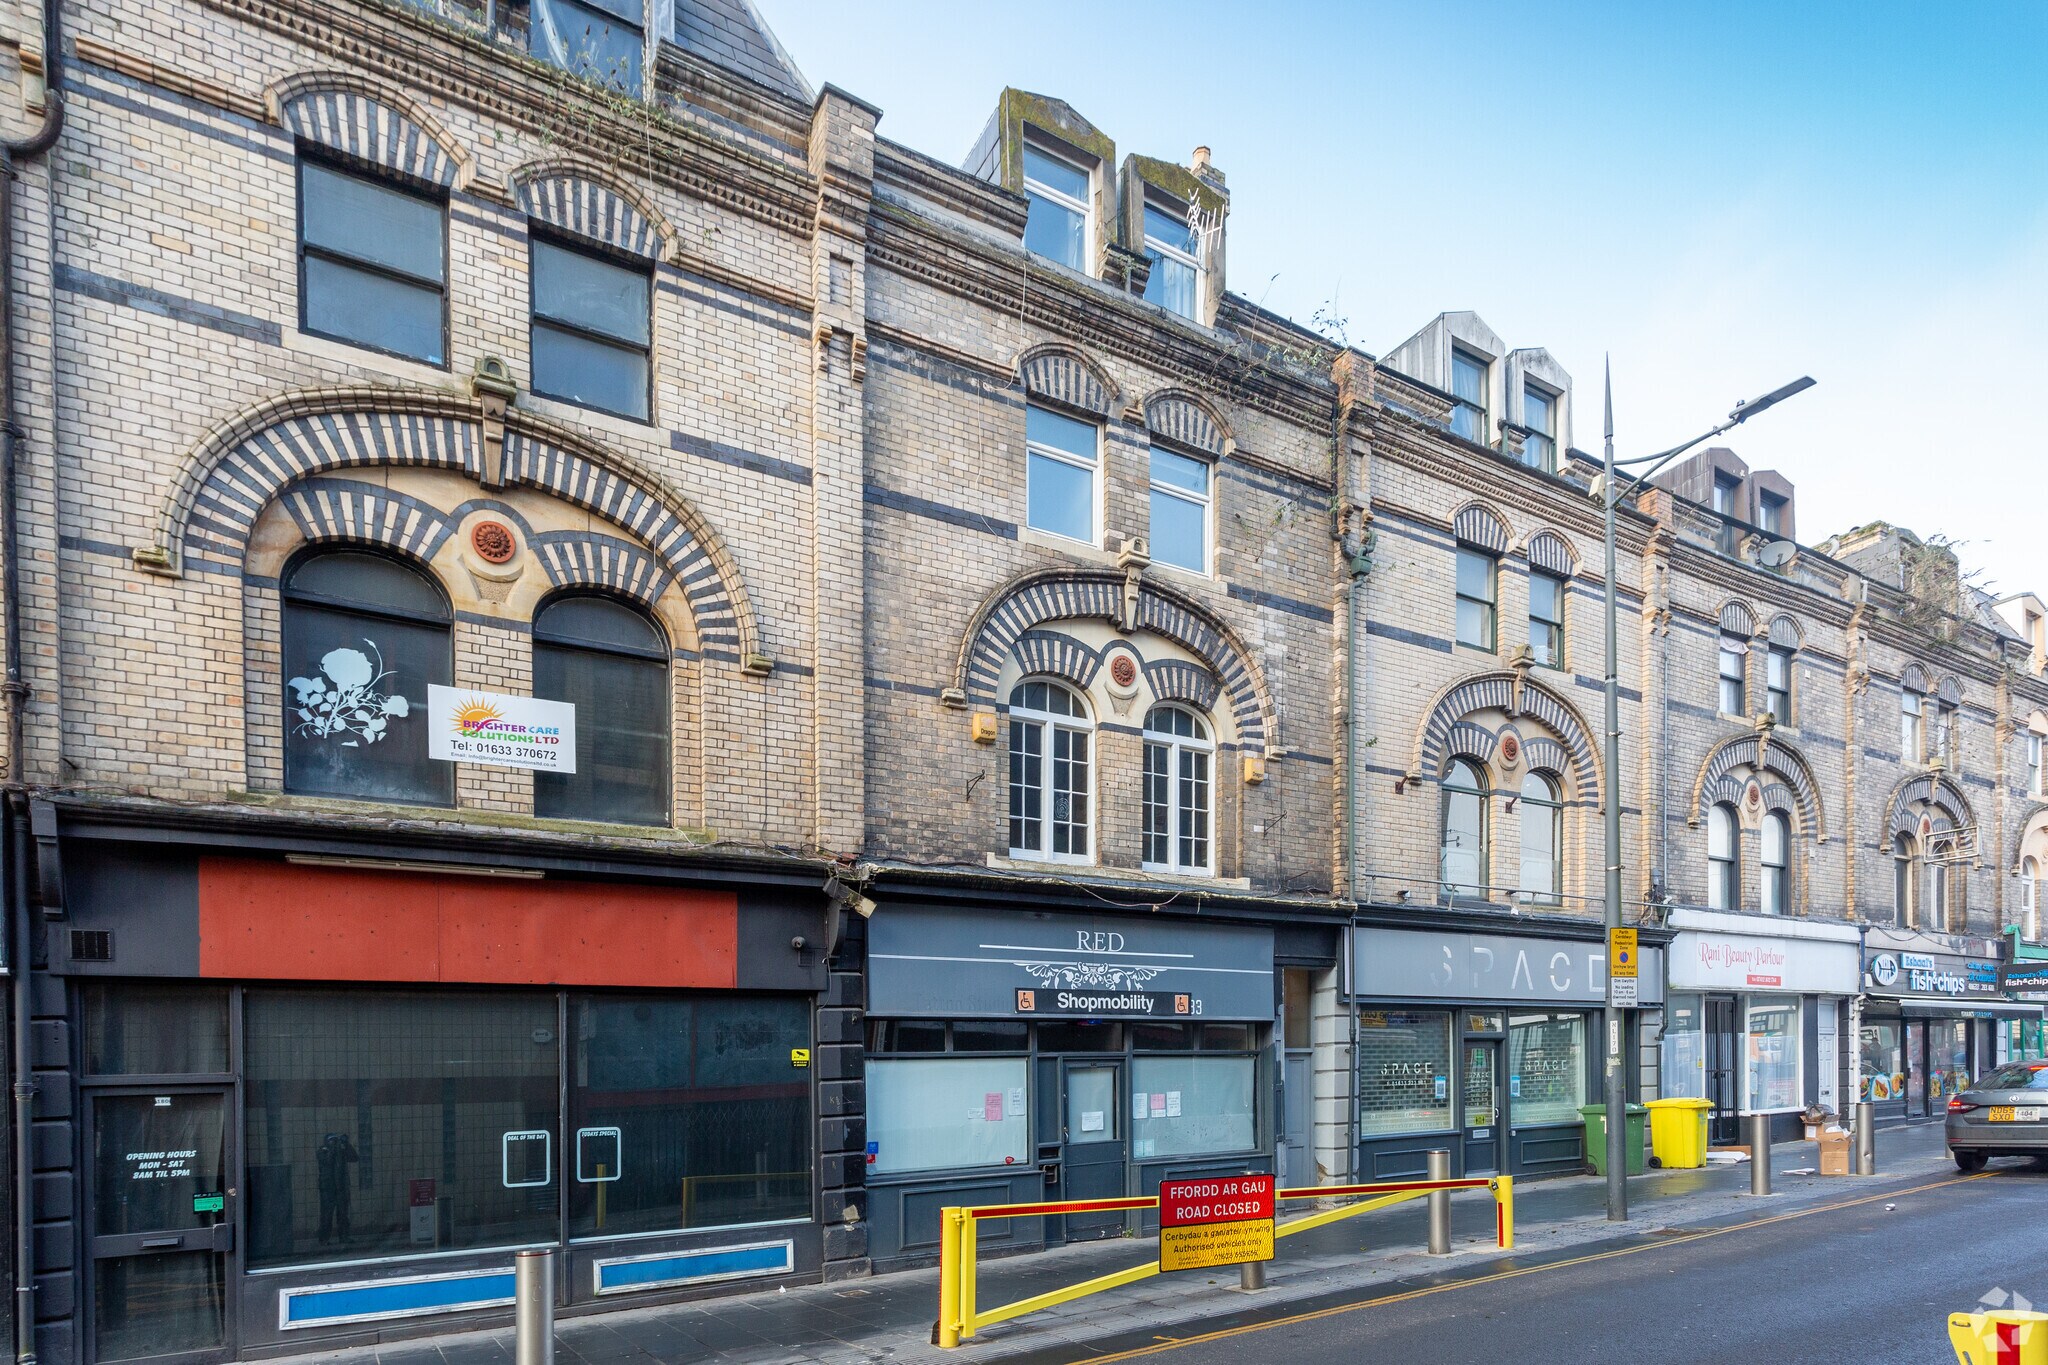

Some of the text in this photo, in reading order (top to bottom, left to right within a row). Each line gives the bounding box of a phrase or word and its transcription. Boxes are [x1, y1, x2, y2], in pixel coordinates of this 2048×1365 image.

[463, 720, 559, 735] BRIGHTER CARE
[980, 728, 995, 736] Dragon
[462, 729, 559, 744] SOLUTIONS LTD
[451, 740, 557, 761] Tel: 01633 370672
[1076, 930, 1125, 952] RED
[1698, 942, 1721, 969] Rani
[1721, 944, 1752, 972] Beauty
[1911, 969, 1965, 995] fish&chips
[1057, 992, 1154, 1013] Shopmobility
[1381, 1062, 1433, 1075] SPACE
[126, 1150, 197, 1160] OPENING HOURS
[168, 1160, 185, 1168] SAT
[155, 1170, 168, 1178] TIL
[171, 1169, 191, 1177] 5PM
[1170, 1181, 1266, 1199] FFORDD AR GAU
[1176, 1201, 1260, 1219] ROAD CLOSED
[1165, 1230, 1202, 1241] Cerbydau
[1174, 1237, 1262, 1253] Authorised vehicles only
